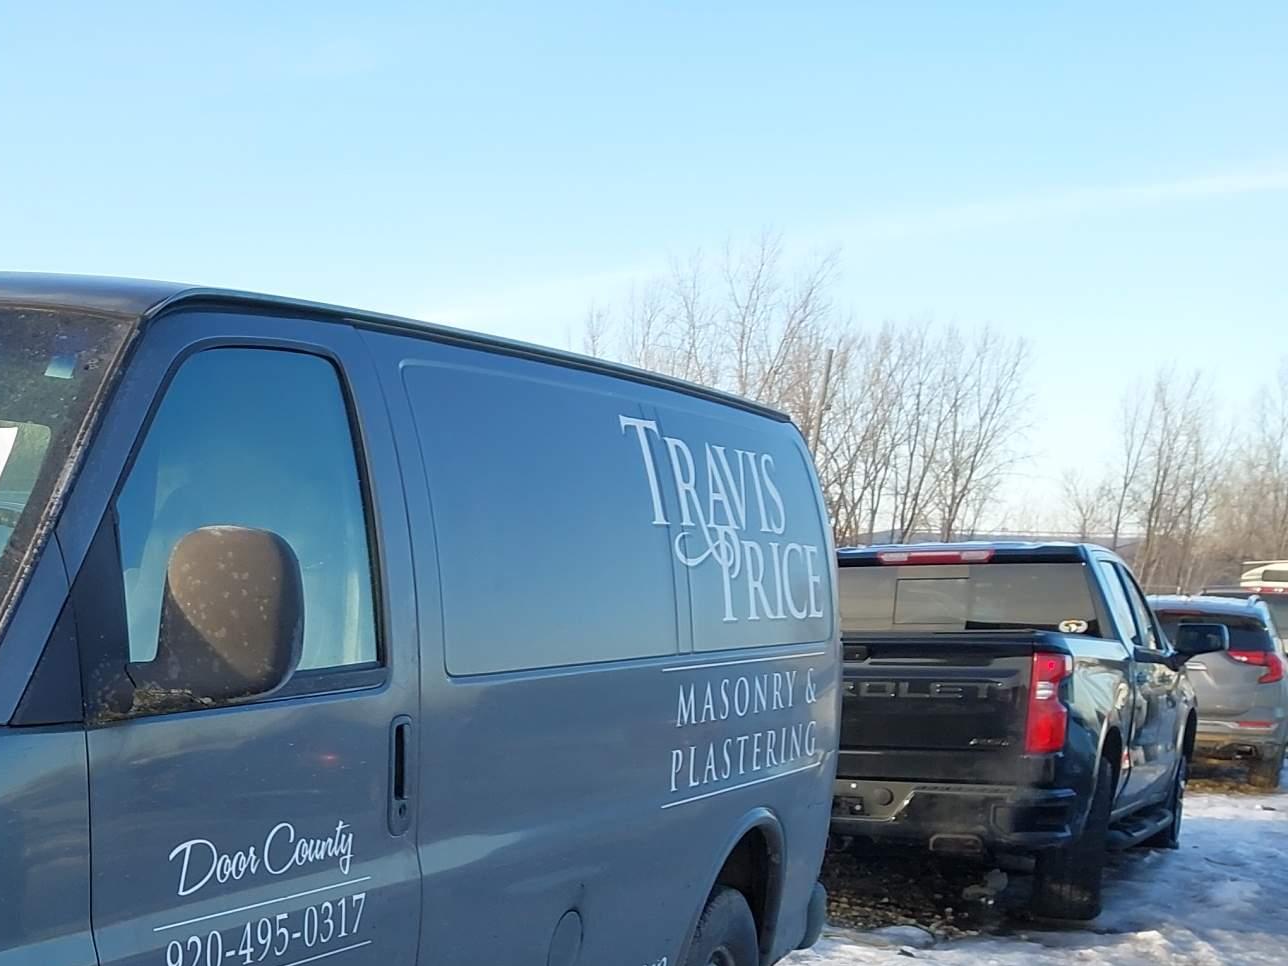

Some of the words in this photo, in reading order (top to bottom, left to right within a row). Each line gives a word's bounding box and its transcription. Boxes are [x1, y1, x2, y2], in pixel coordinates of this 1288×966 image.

[618, 414, 786, 562] TRAVIS
[714, 526, 824, 622] PRICE
[675, 669, 798, 729] MASONRY
[805, 667, 818, 704] &
[669, 720, 818, 793] PLASTERING
[168, 838, 261, 897] Door
[263, 819, 355, 875] County
